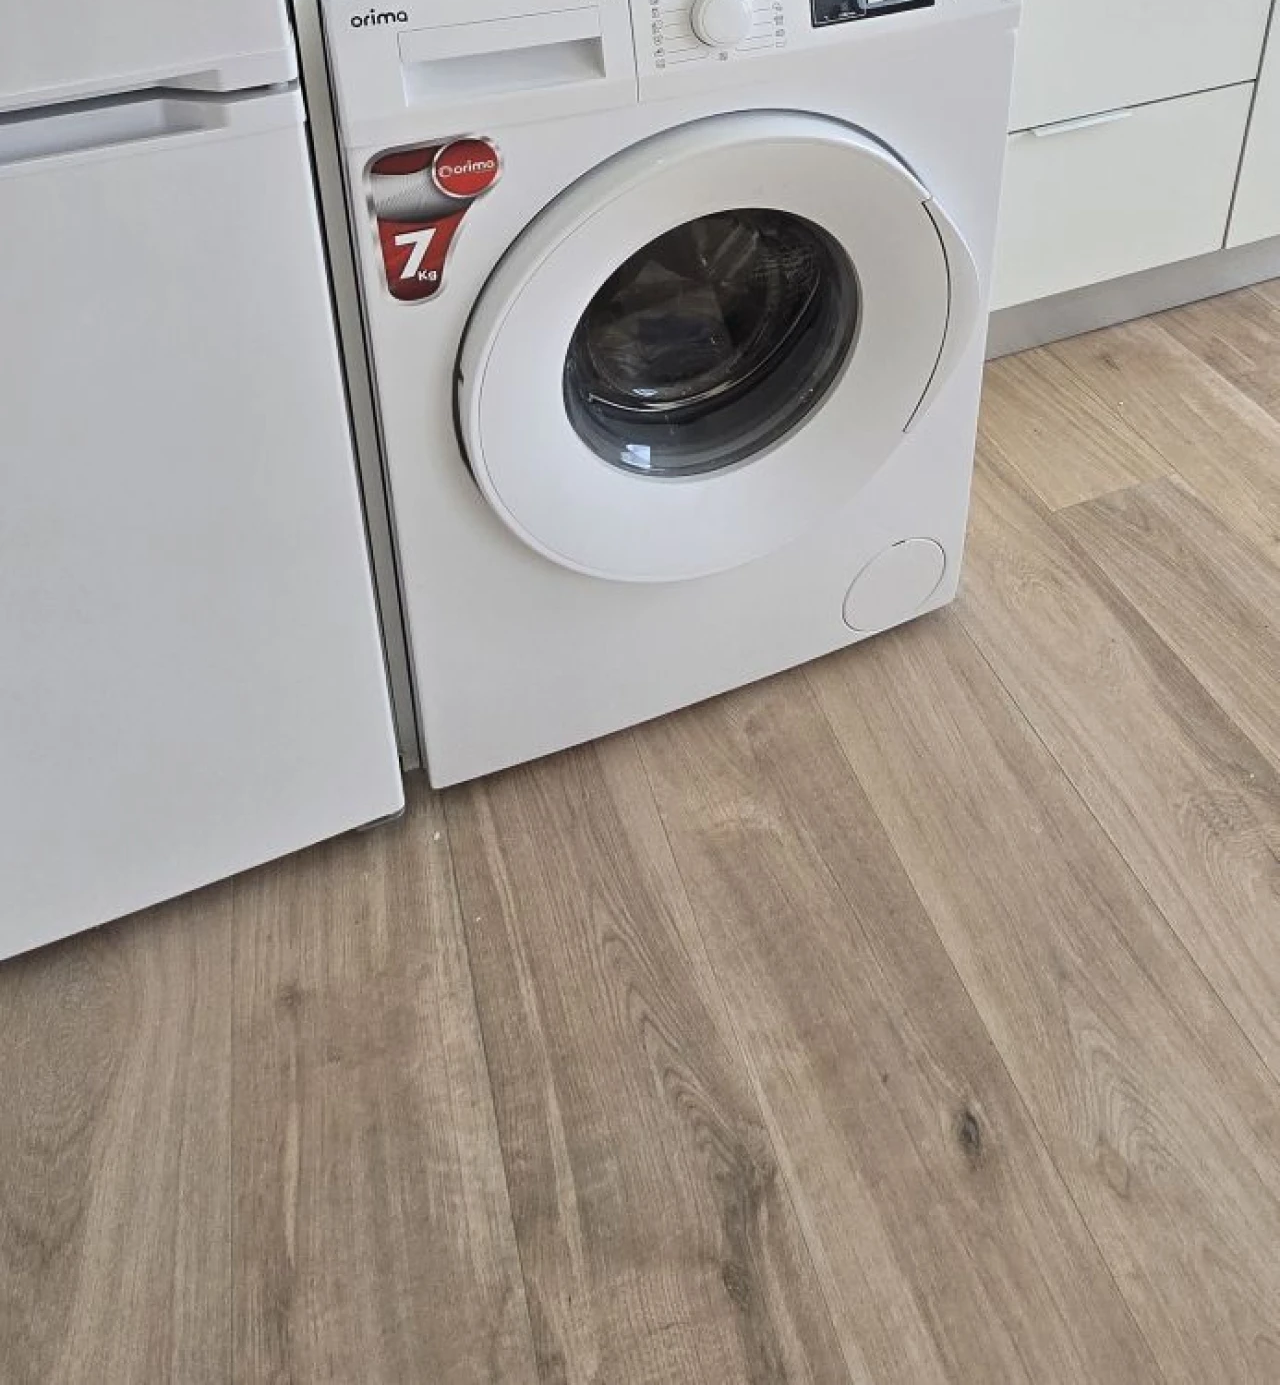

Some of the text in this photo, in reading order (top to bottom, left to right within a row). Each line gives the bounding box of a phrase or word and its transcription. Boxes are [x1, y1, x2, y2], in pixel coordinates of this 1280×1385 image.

[350, 8, 408, 28] orima
[453, 159, 495, 174] orima
[394, 227, 437, 279] 7
